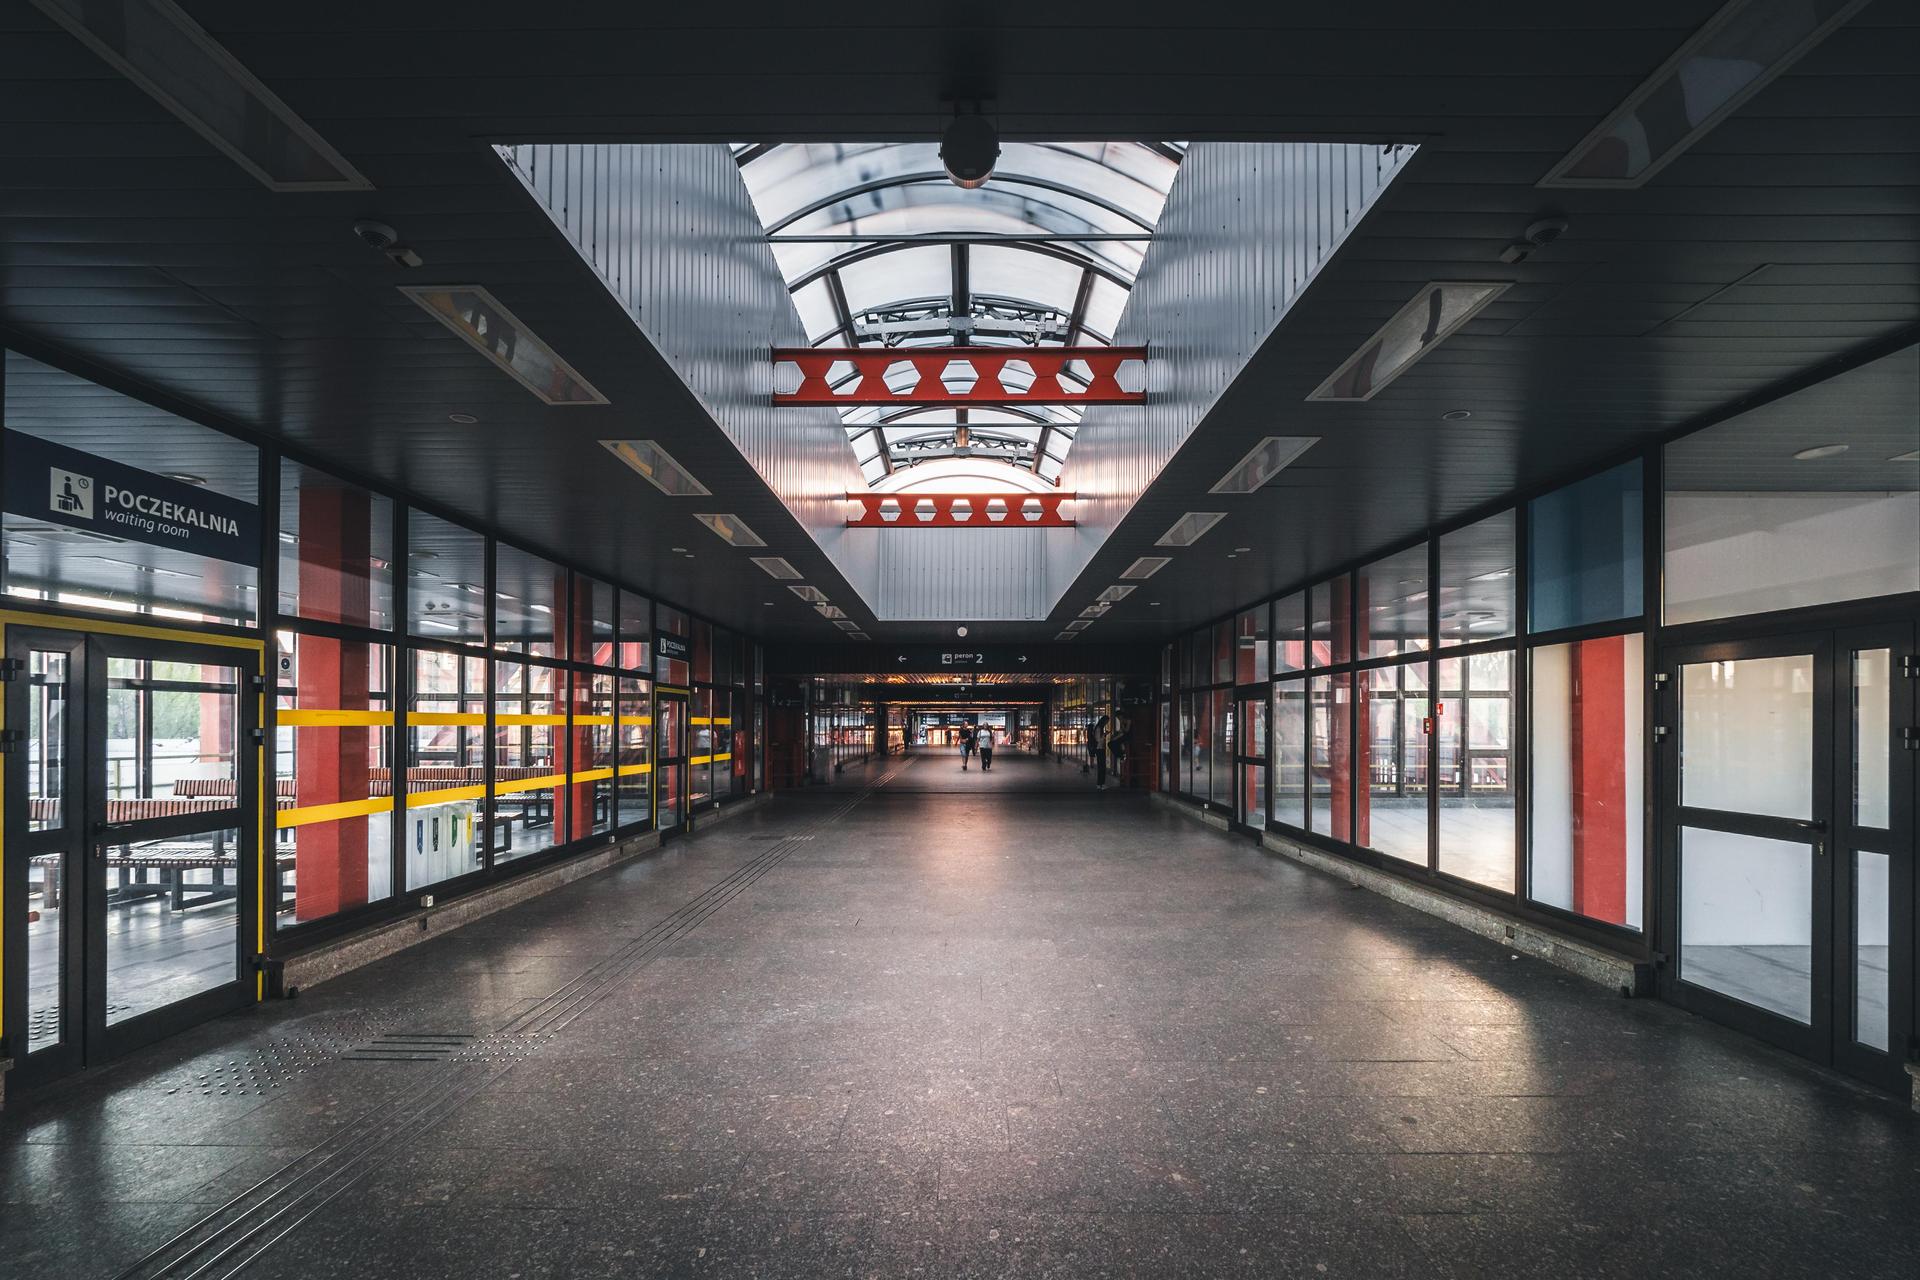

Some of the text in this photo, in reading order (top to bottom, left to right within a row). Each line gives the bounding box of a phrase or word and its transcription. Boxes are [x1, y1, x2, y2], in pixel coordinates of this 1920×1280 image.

[104, 485, 239, 536] POCZEKALNIA
[105, 509, 189, 539] waiting room
[975, 653, 983, 664] 2
